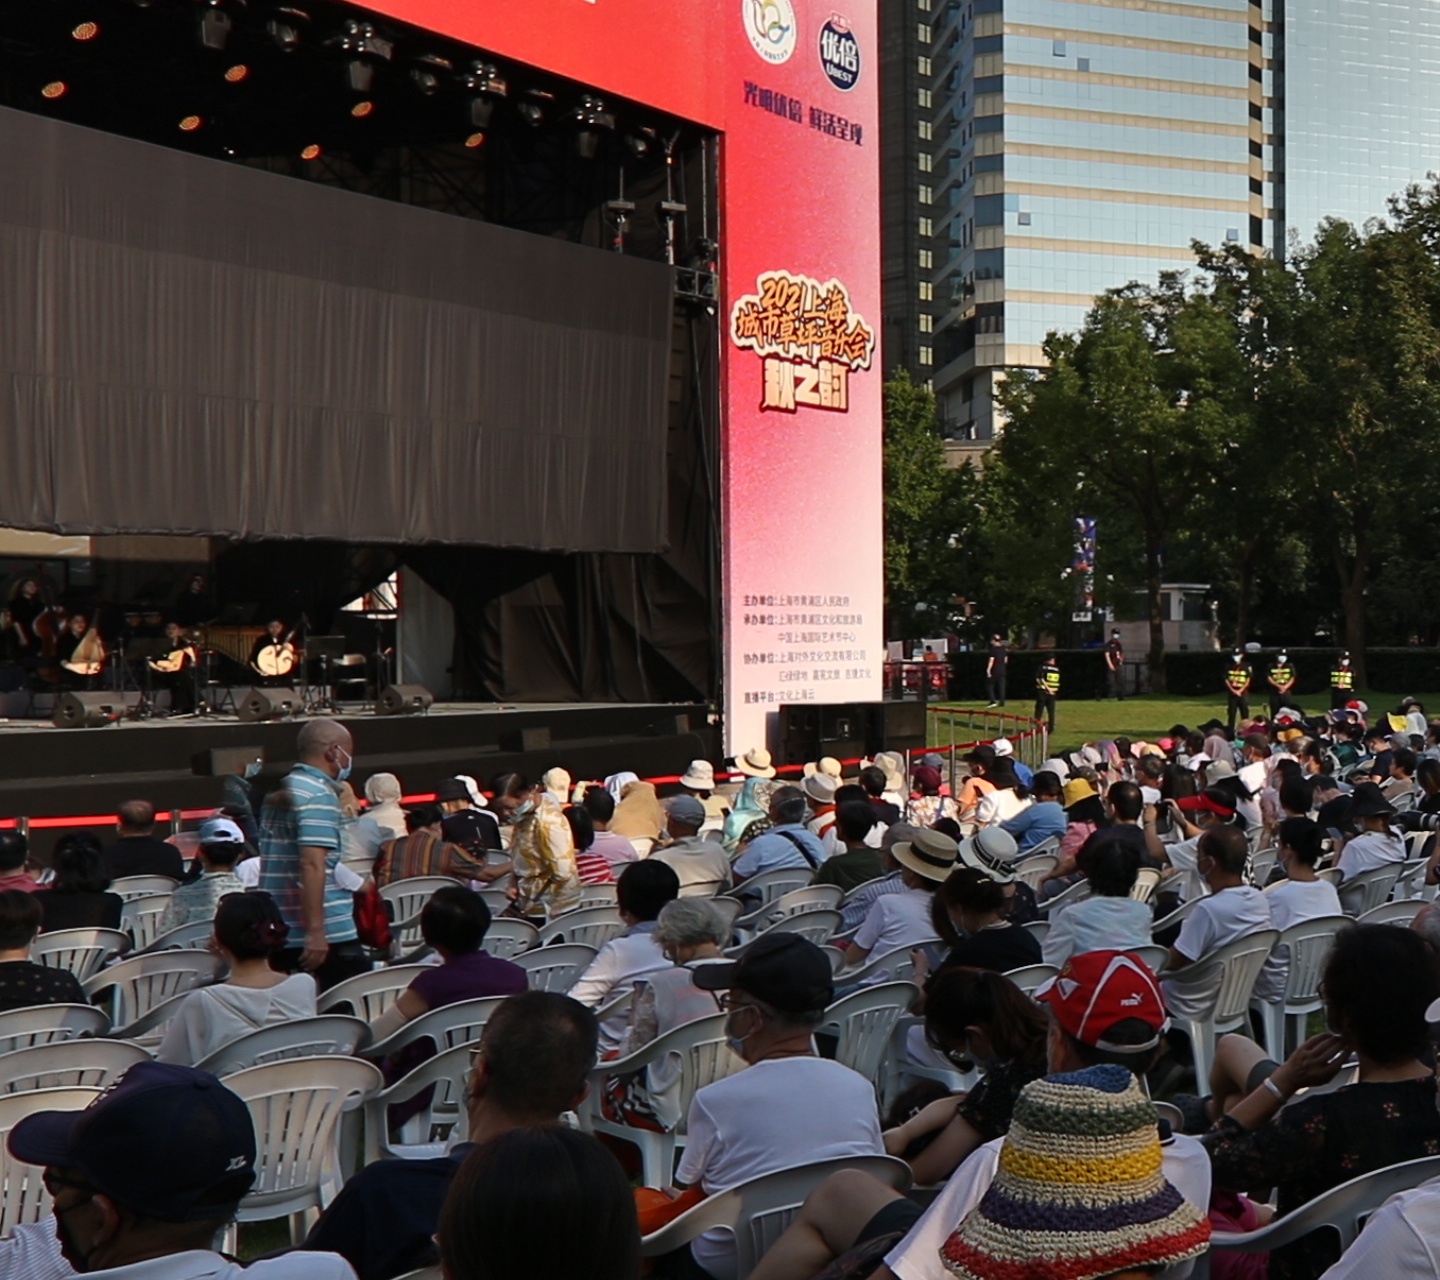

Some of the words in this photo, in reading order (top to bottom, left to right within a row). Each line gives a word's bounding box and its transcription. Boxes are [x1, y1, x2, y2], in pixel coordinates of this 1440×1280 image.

[821, 29, 858, 73] 优倍
[760, 276, 849, 327] 2021上海
[736, 301, 872, 362] 城市草坪音乐会
[761, 357, 850, 410] 秋之韵
